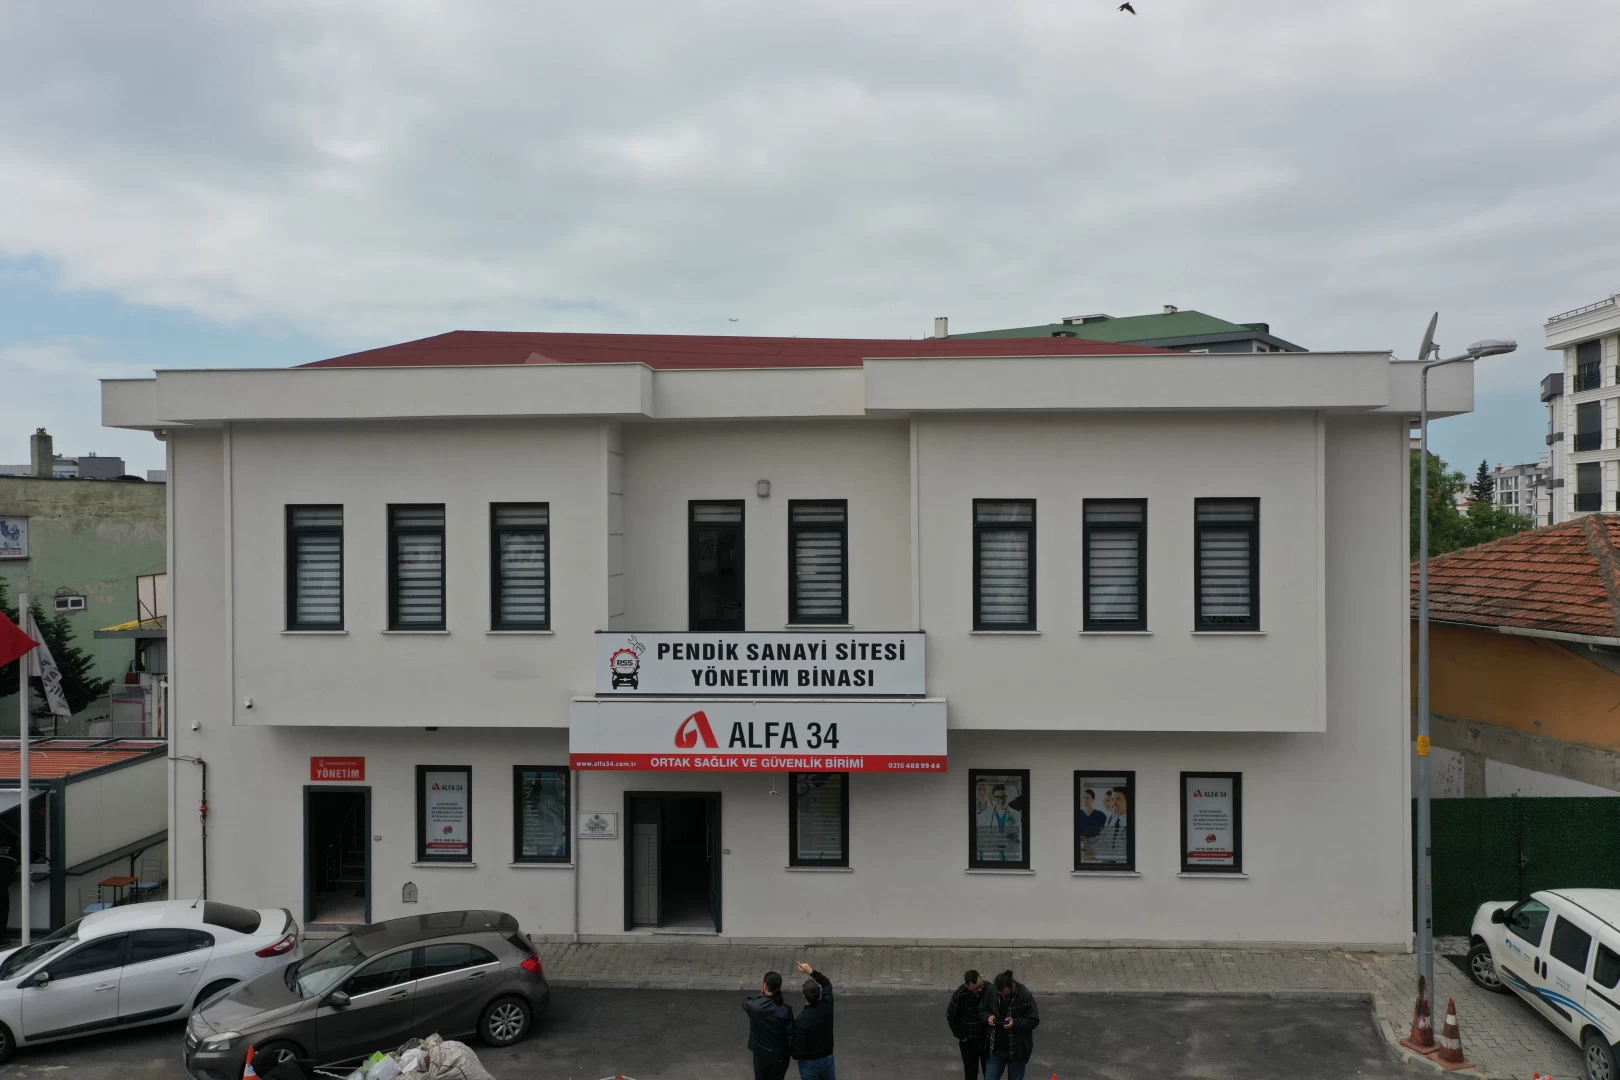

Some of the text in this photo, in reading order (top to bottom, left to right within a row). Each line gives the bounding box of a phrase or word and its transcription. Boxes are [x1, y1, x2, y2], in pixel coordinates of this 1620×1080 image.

[658, 639, 906, 661] PENDİK SANAYİ SİTESİ
[690, 666, 874, 687] YÖNETİM BİNASI
[728, 721, 839, 749] ALFA 34
[316, 767, 360, 778] YÖNETİM
[650, 756, 864, 768] ORTAK SAĞLIK VE GÜVENLİK BİRİMİ
